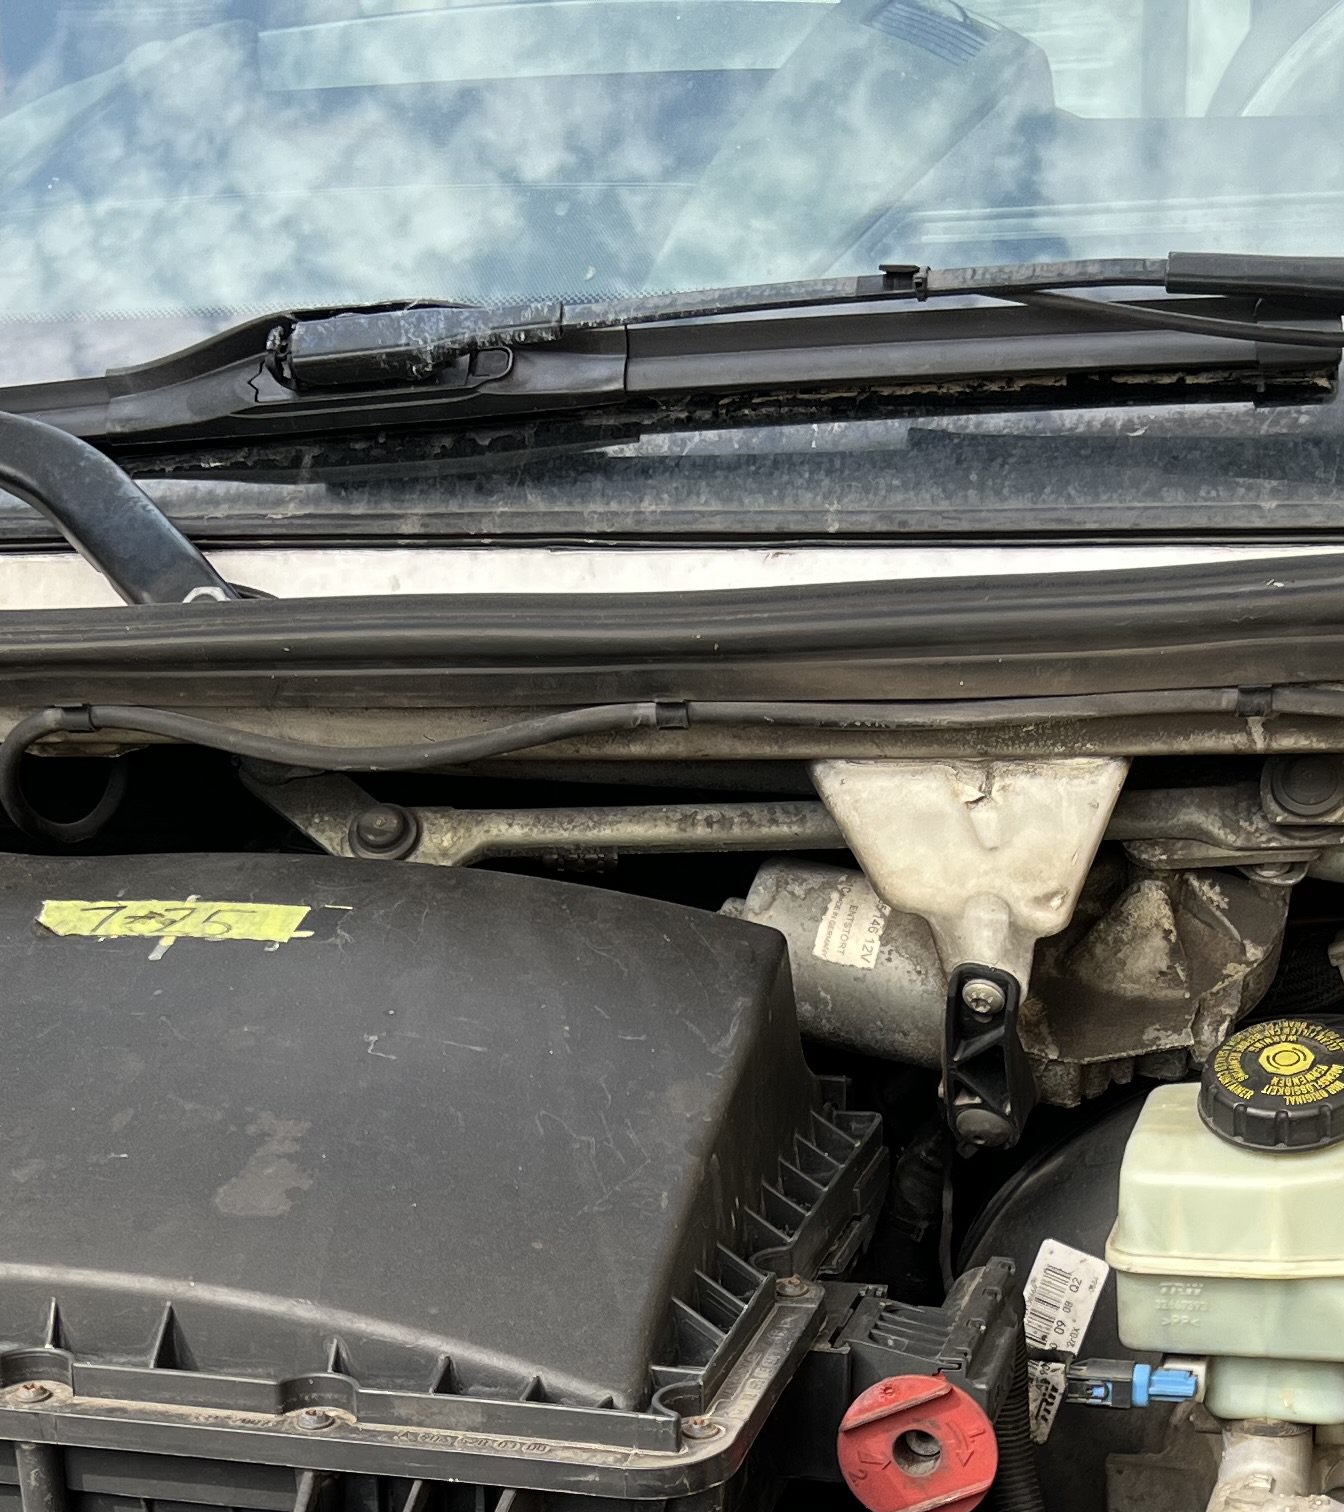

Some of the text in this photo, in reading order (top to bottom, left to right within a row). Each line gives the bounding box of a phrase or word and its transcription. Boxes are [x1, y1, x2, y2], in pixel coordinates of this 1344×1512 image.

[860, 938, 875, 964] 12V
[1247, 1034, 1297, 1052] WARNING
[1283, 1090, 1328, 1105] ORIGINAL
[1053, 1320, 1067, 1335] 09
[1069, 1277, 1083, 1293] Q2
